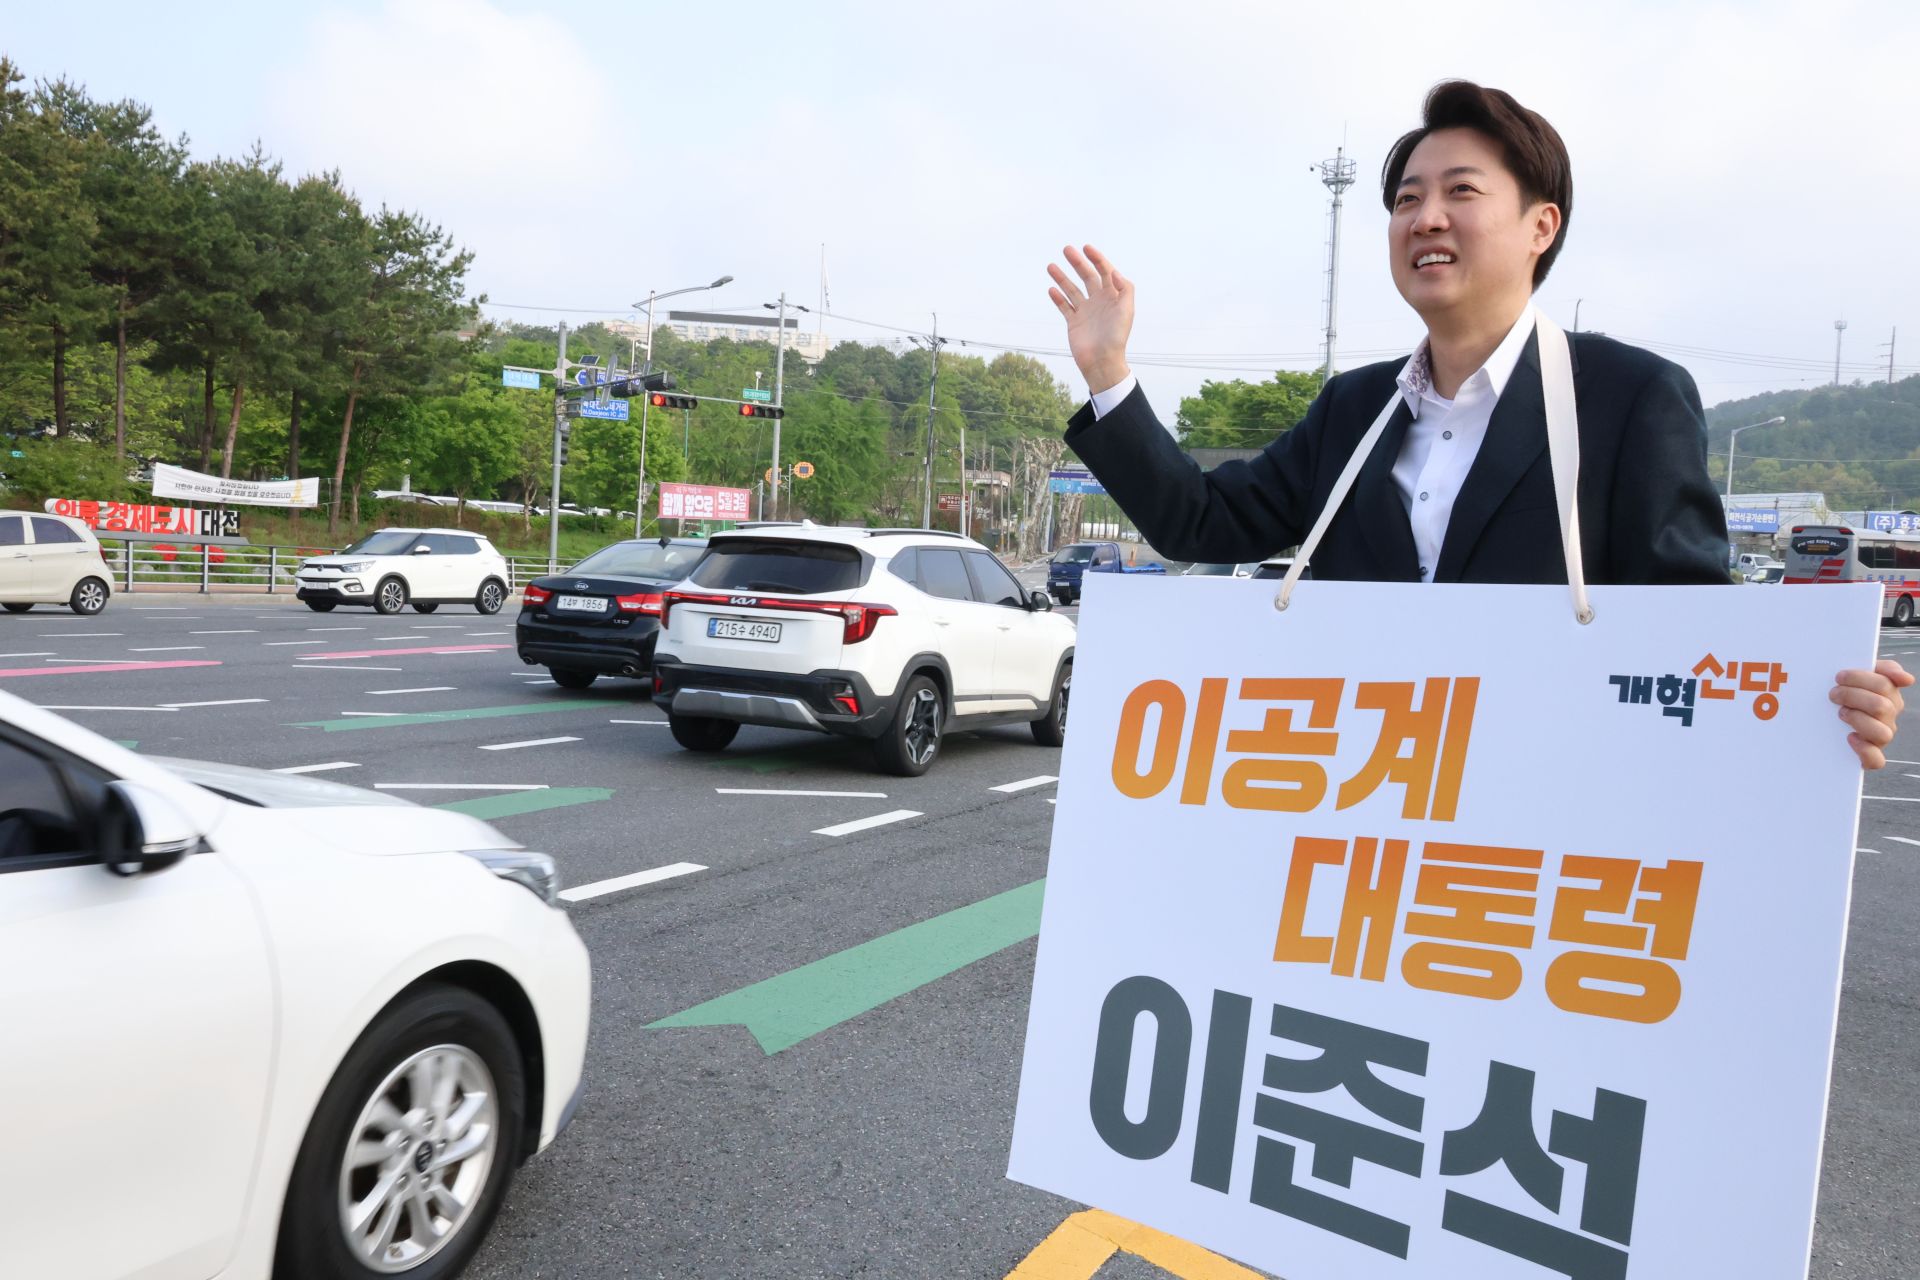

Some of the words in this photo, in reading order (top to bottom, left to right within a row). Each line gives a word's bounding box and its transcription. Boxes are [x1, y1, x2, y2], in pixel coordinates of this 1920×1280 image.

[106, 501, 195, 536] 경제도시
[201, 510, 241, 537] 대전
[662, 492, 683, 516] 함께
[684, 494, 713, 517] 앞으로
[718, 491, 732, 511] 5월
[733, 492, 747, 512] 3일
[1874, 515, 1896, 530] (주)
[582, 598, 603, 609] 1856
[717, 622, 746, 636] 215수
[748, 624, 777, 639] 4940
[1609, 653, 1788, 727] 개혁신당
[1111, 676, 1481, 823] 이공계
[1273, 836, 1704, 1024] 대통령
[1089, 975, 1647, 1280] 이준석
